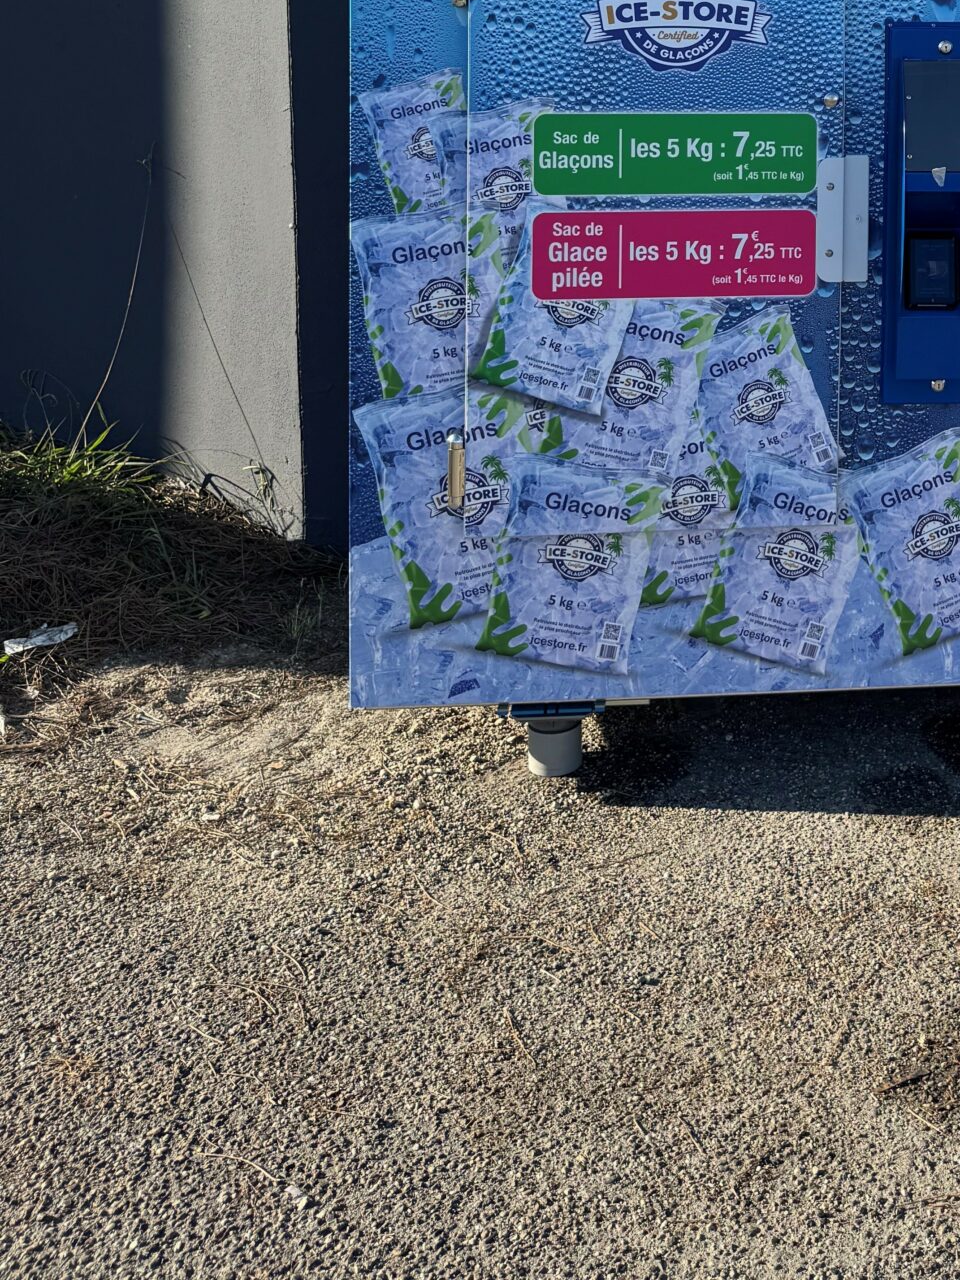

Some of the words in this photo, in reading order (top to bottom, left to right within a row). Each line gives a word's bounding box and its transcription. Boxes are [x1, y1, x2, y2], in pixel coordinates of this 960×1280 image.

[606, 0, 750, 26] ICE-STORE
[657, 30, 700, 42] Certified
[643, 39, 657, 54] DE
[660, 38, 714, 62] GLAÇONS
[391, 98, 448, 120] Glaçons
[464, 133, 532, 155] Glaçons
[553, 131, 578, 144] Sac
[583, 131, 600, 144] de
[630, 138, 661, 158] les
[667, 138, 680, 158] 5
[687, 138, 713, 161] Kg
[732, 131, 776, 160] 7,25
[781, 145, 804, 157] TTC
[539, 150, 614, 173] Glaçons
[713, 171, 733, 182] (soit
[761, 171, 778, 180] TTC
[780, 171, 788, 180] le
[790, 171, 805, 182] Kg)
[479, 183, 531, 200] ICE-STORE
[552, 222, 580, 236] Sac
[586, 222, 604, 236] de
[392, 240, 473, 264] Glaçons
[549, 241, 607, 262] Glace
[629, 241, 659, 261] les
[666, 241, 678, 261] 5
[685, 241, 712, 264] Kg
[780, 247, 802, 259] TTC
[552, 267, 603, 292] pilée
[712, 275, 732, 286] (soit
[760, 275, 776, 283] TTC
[778, 274, 786, 283] le
[788, 274, 803, 285] Kg)
[433, 348, 440, 359] 5
[443, 346, 458, 358] kg
[549, 338, 562, 352] kg
[709, 343, 777, 378] Glaçons
[737, 391, 784, 416] ICE-STORE
[600, 421, 607, 431] 5
[610, 422, 624, 437] kg
[768, 435, 780, 446] kg
[881, 470, 954, 508] Glaçons
[545, 491, 632, 522] Glaçons
[662, 493, 717, 511] ICE-STORE
[774, 492, 849, 524] Glaçons
[460, 541, 468, 552] 5
[472, 537, 488, 551] kg
[678, 535, 685, 546] 5
[688, 533, 701, 546] kg
[548, 547, 610, 568] ICE-STORE
[767, 545, 821, 569] ICE-STORE
[934, 577, 941, 588] 5
[943, 573, 957, 585] kg
[548, 594, 556, 606] 5
[559, 595, 573, 610] kg
[761, 590, 769, 601] 5
[771, 591, 784, 607] kg
